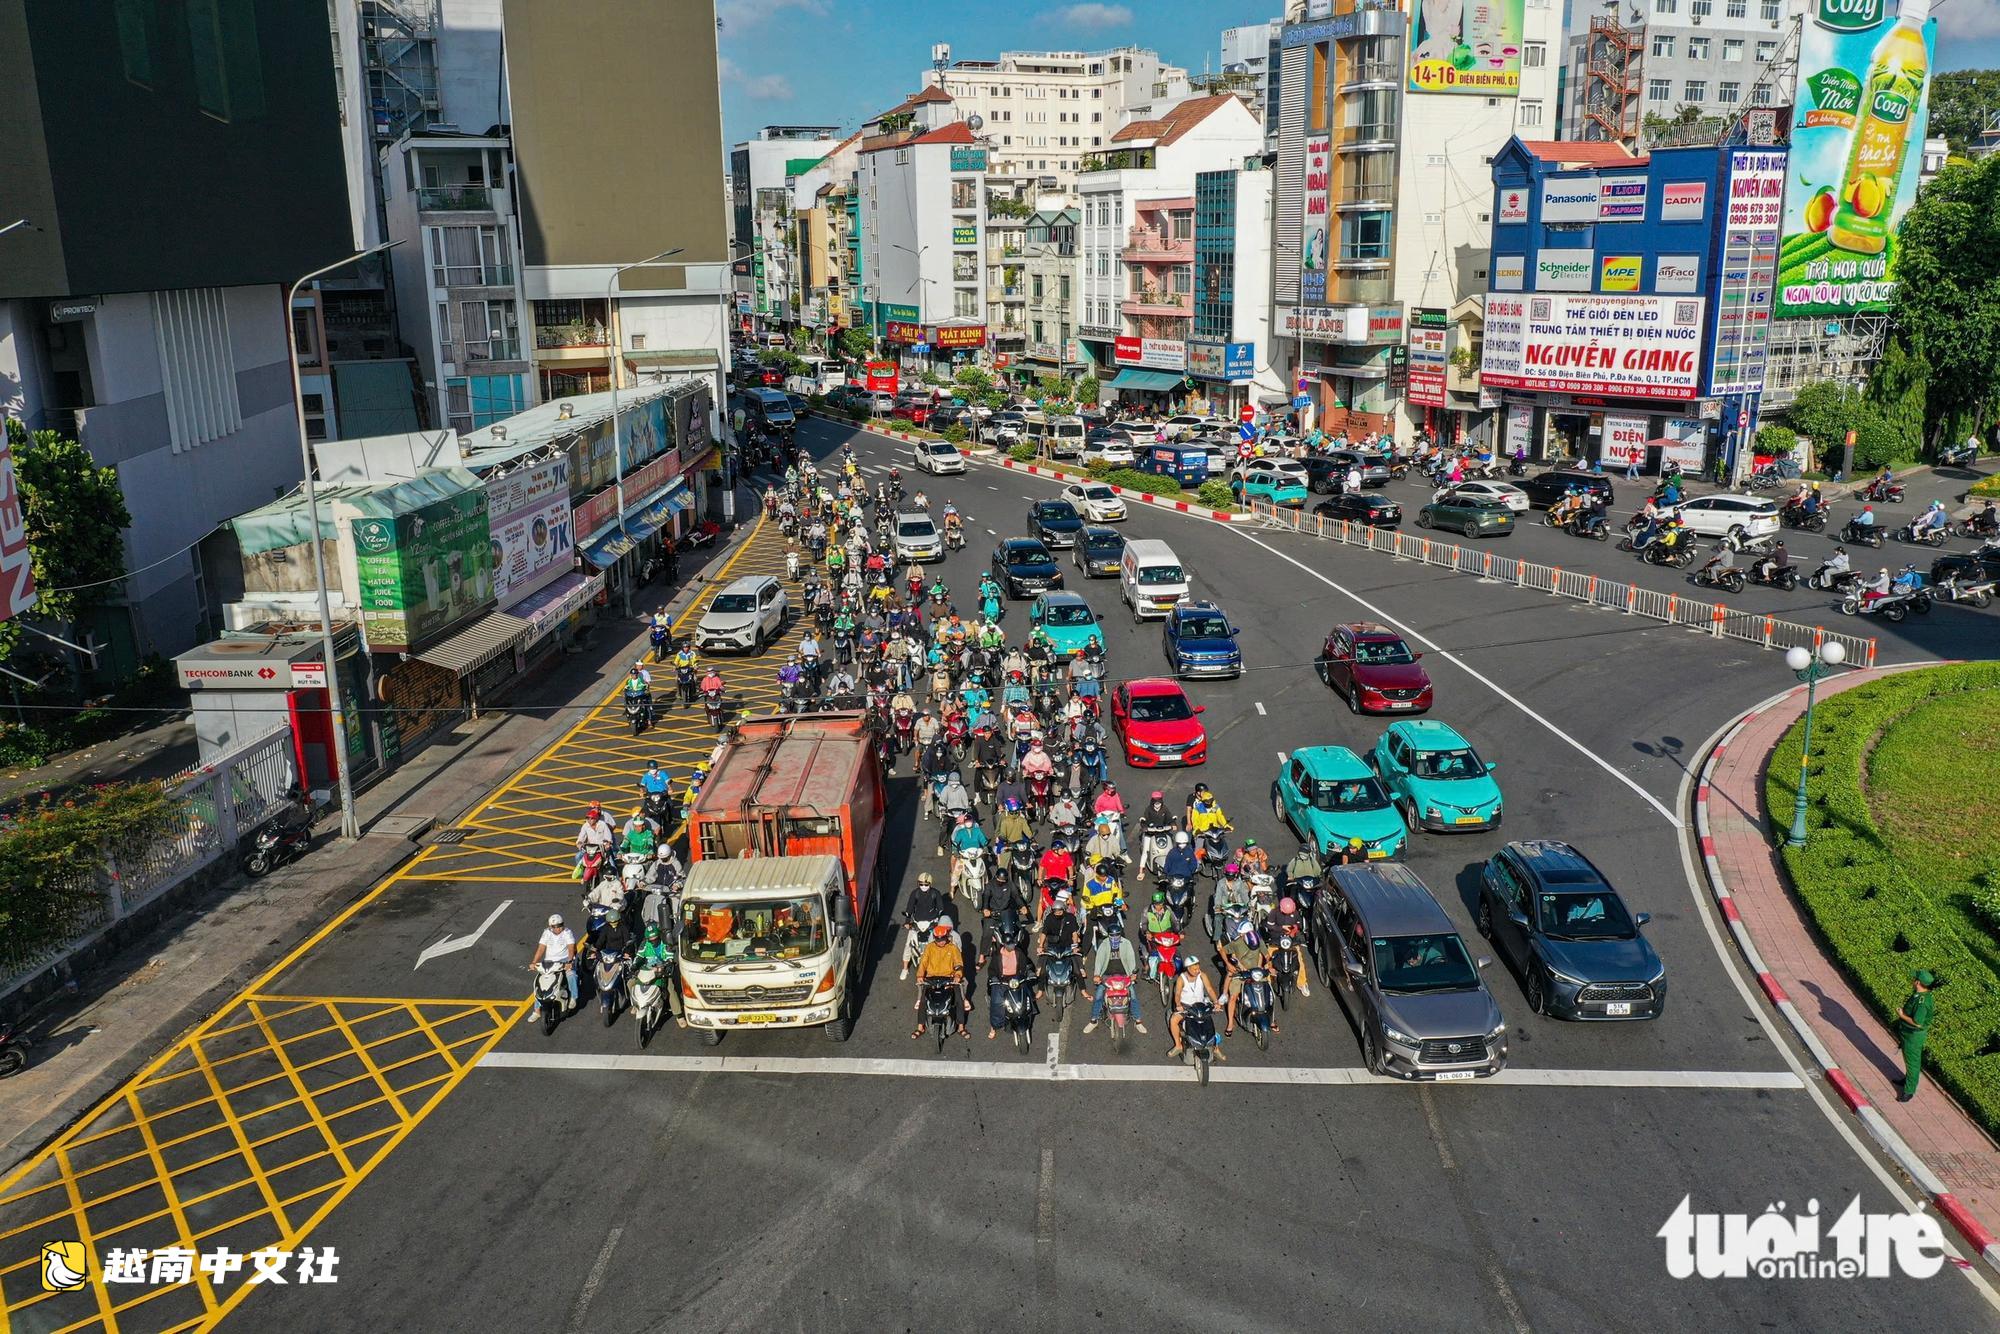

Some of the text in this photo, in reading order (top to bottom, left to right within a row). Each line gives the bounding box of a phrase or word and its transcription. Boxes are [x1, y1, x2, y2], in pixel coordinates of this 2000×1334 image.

[1414, 65, 1455, 84] 14-16
[1874, 95, 1907, 119] Cozy
[1545, 194, 1598, 204] Panasonic
[1730, 204, 1778, 213] 0906 679 300
[1730, 215, 1777, 224] 0909 209 300
[1540, 262, 1590, 272] Schneider
[1606, 268, 1637, 276] MPE
[1806, 252, 1886, 280] TRÀ HOA QUẢ
[1786, 286, 1810, 302] NGON
[1568, 297, 1658, 306] www.nguyengiang.vn
[1566, 306, 1658, 320] THẾ GIỚI ĐÈN LED
[1317, 318, 1344, 333] ANH
[1388, 318, 1400, 329] ANH
[960, 327, 982, 338] KÍNH
[1530, 324, 1696, 341] TRUNG TÂM THIẾT BỊ ĐIỆN NƯỚC
[1526, 338, 1694, 372] NGUYỄN GIANG
[1559, 370, 1574, 378] Điện
[1628, 374, 1644, 382] Kao,
[1662, 376, 1690, 384] TP.HCM
[1525, 379, 1548, 388] HOTLINE:
[1666, 388, 1678, 396] 819
[1670, 420, 1699, 428] MPE
[1613, 429, 1643, 444] ĐIỆN
[553, 463, 567, 488] 7K
[549, 522, 569, 556] 7K
[184, 670, 254, 678] TECHCOMBANK
